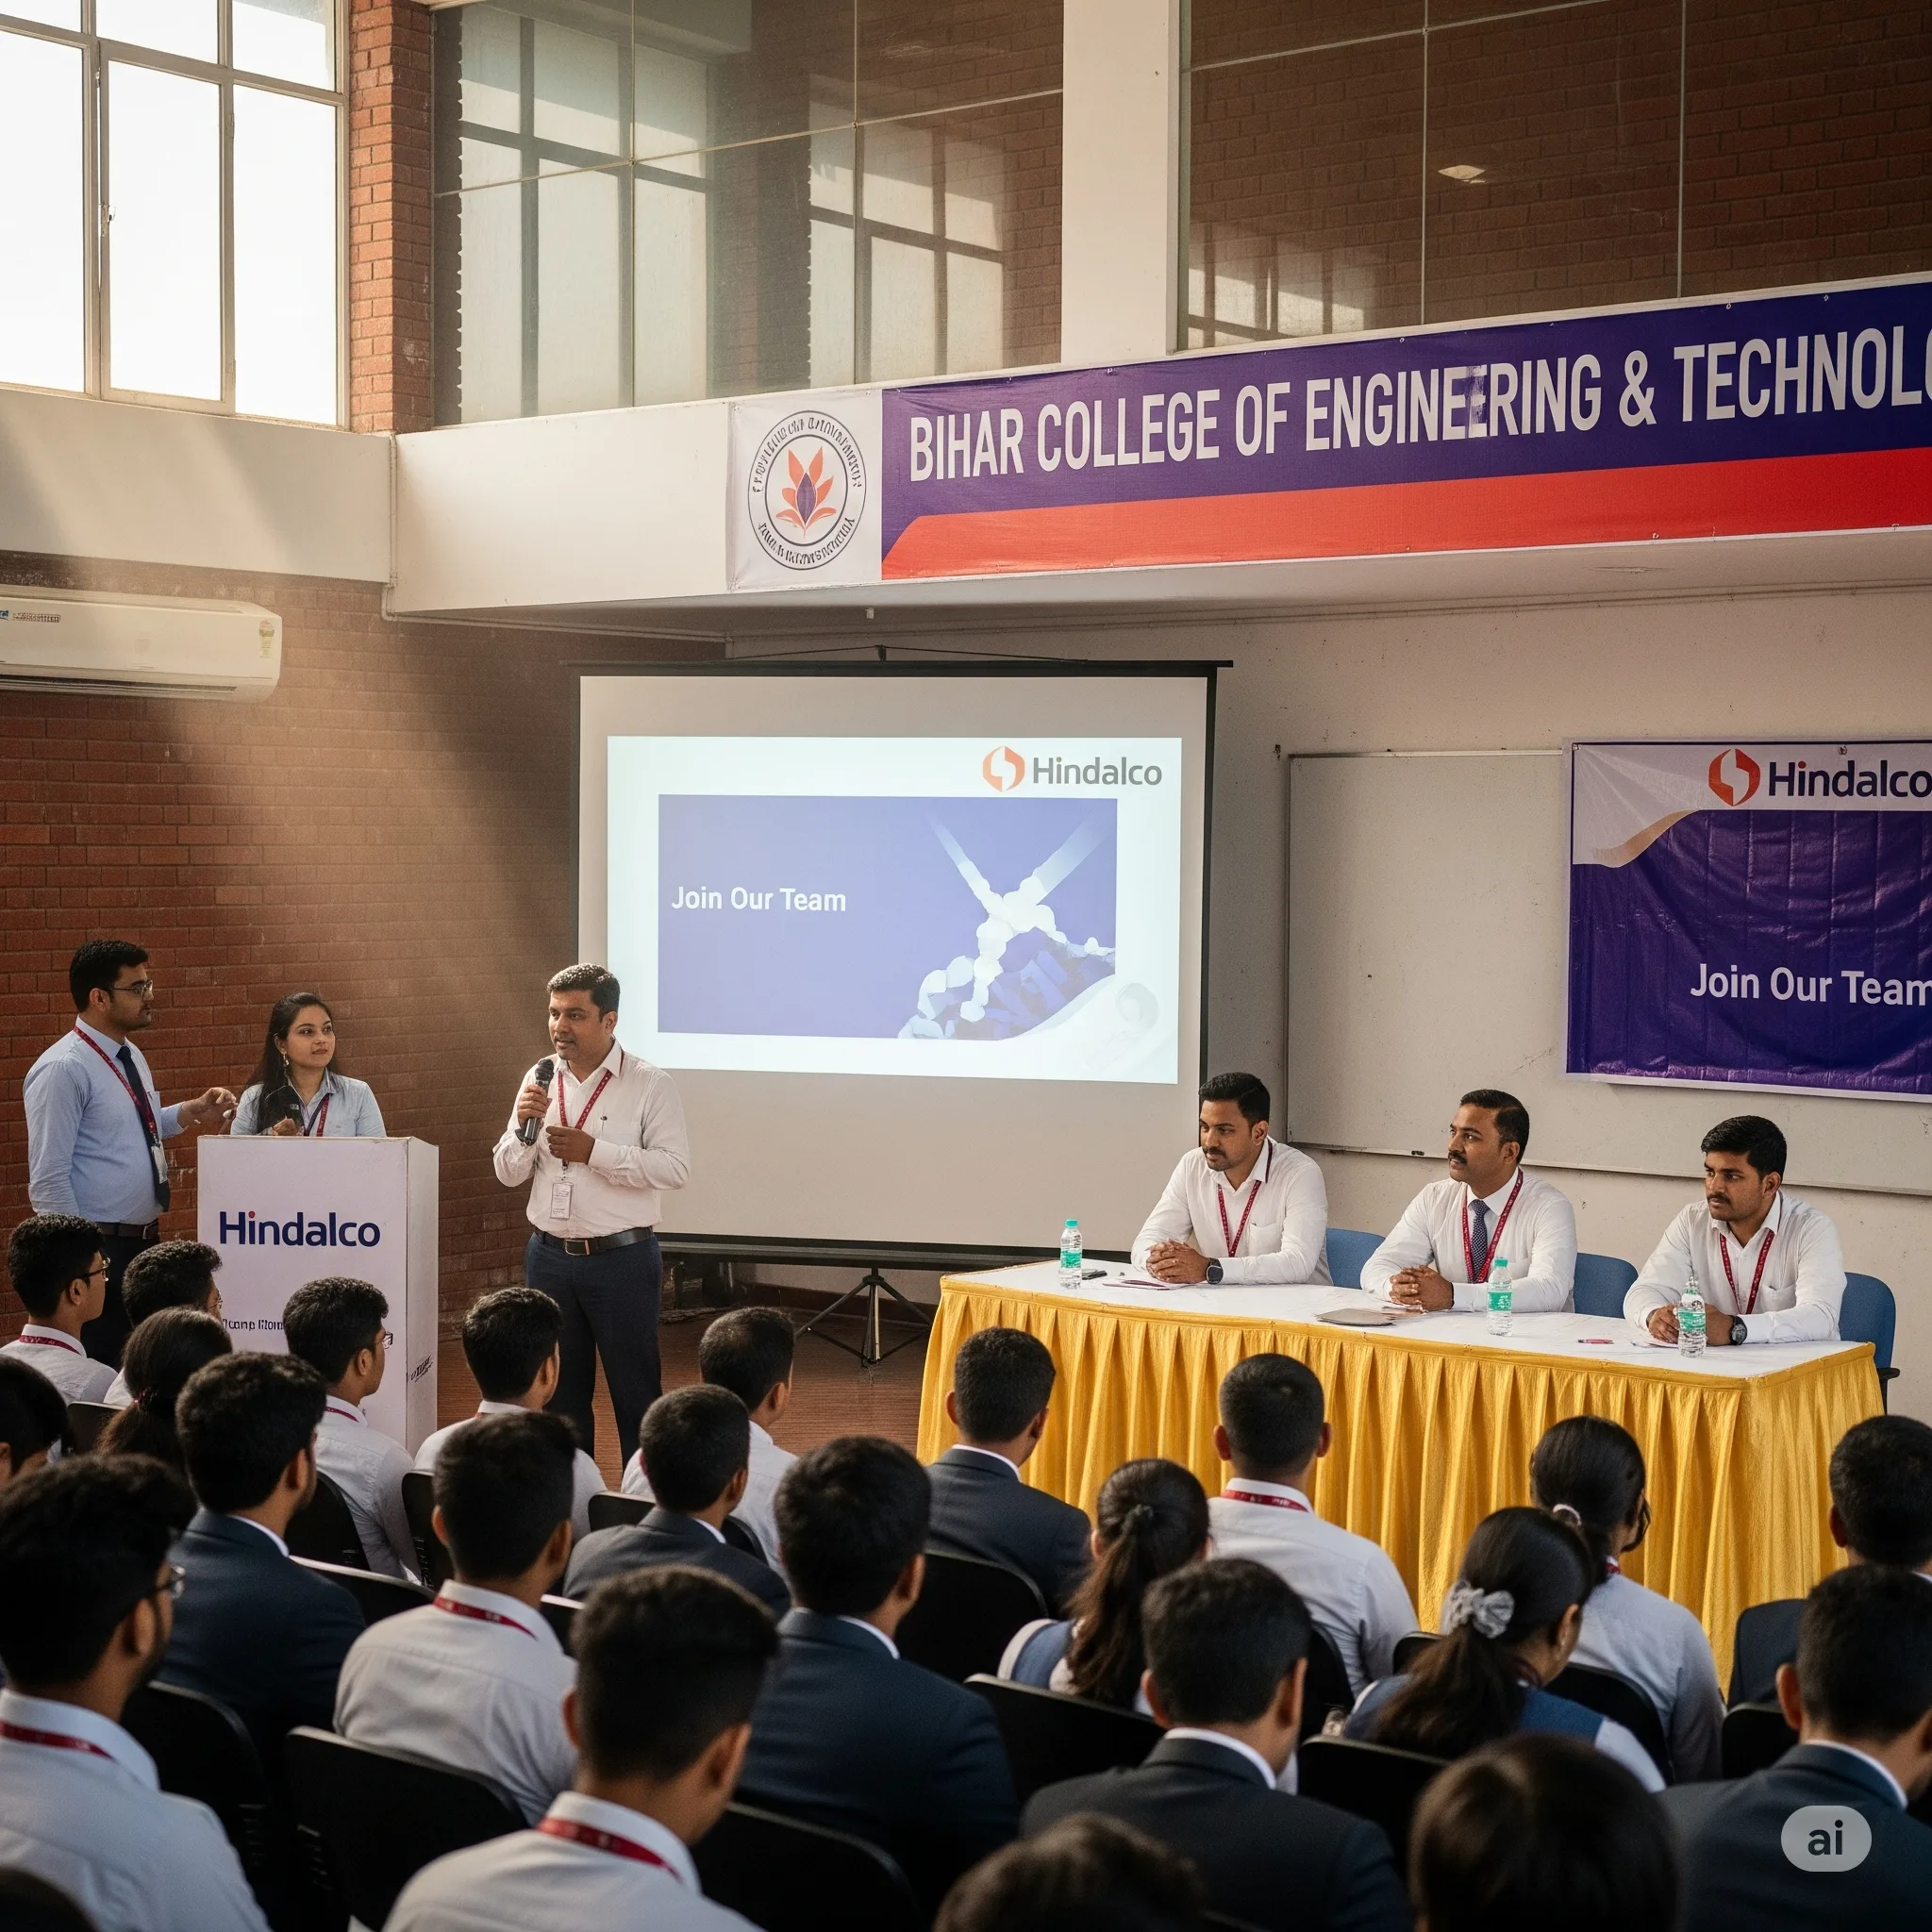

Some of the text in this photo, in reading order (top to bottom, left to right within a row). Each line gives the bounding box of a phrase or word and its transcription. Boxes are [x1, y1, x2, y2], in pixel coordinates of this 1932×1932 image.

[909, 408, 1024, 481] BIHAR
[1038, 390, 1220, 472] COLLEGE
[1235, 381, 1291, 457] OF
[1304, 353, 1601, 451] ENGINEERING
[1619, 349, 1657, 428] &
[1674, 325, 1932, 422] TECHNOL
[1032, 756, 1163, 787] Hindalco
[1768, 759, 1932, 798] Hindalco
[671, 886, 847, 913] Join Our Team
[1690, 963, 1932, 1007] Join Our Team
[219, 1210, 381, 1247] Hindalco
